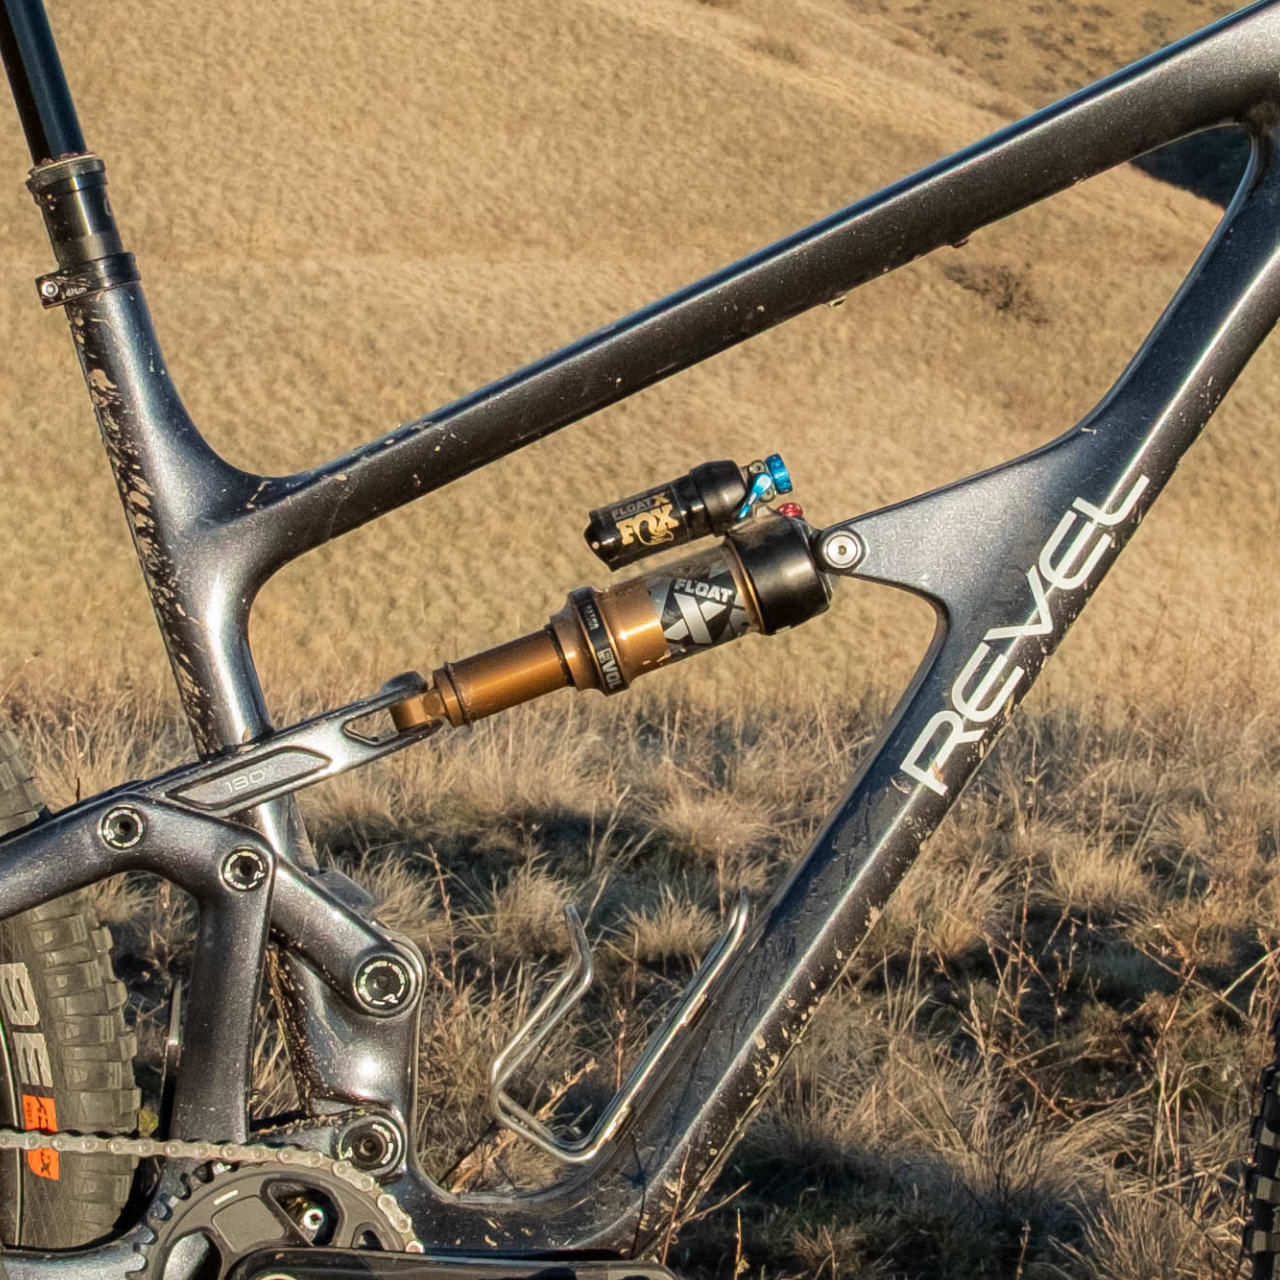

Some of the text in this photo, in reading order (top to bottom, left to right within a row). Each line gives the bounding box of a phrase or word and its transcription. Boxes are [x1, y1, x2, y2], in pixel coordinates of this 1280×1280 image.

[611, 500, 652, 520] FLOAT
[615, 504, 679, 546] FOX
[673, 579, 733, 601] FLOAT
[899, 475, 1149, 796] REVEL
[596, 648, 624, 690] EVOL
